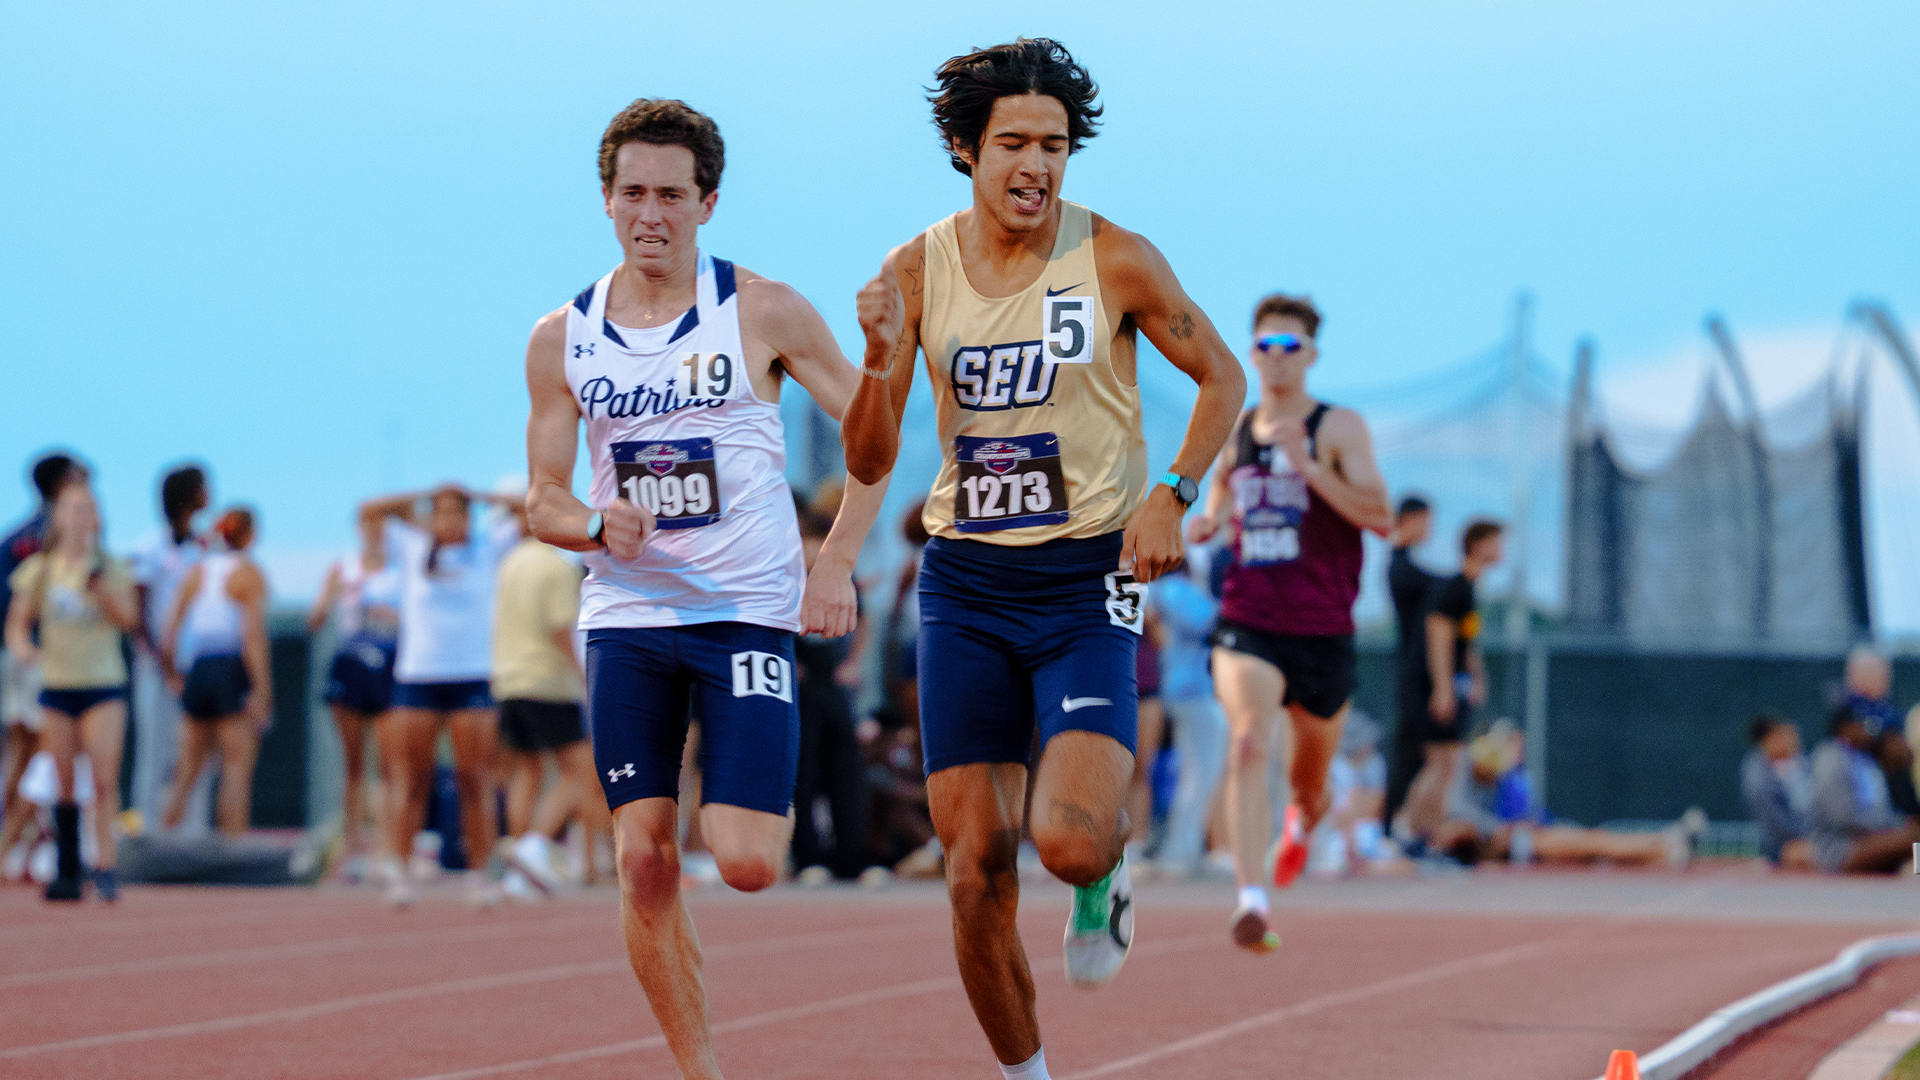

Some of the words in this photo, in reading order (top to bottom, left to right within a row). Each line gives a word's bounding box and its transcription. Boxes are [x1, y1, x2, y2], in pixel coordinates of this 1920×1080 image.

[1048, 301, 1085, 359] 5
[682, 353, 732, 397] 19
[952, 340, 1059, 411] SEU
[622, 473, 712, 517] 1099
[961, 471, 1053, 518] 1273
[738, 653, 782, 694] 19
